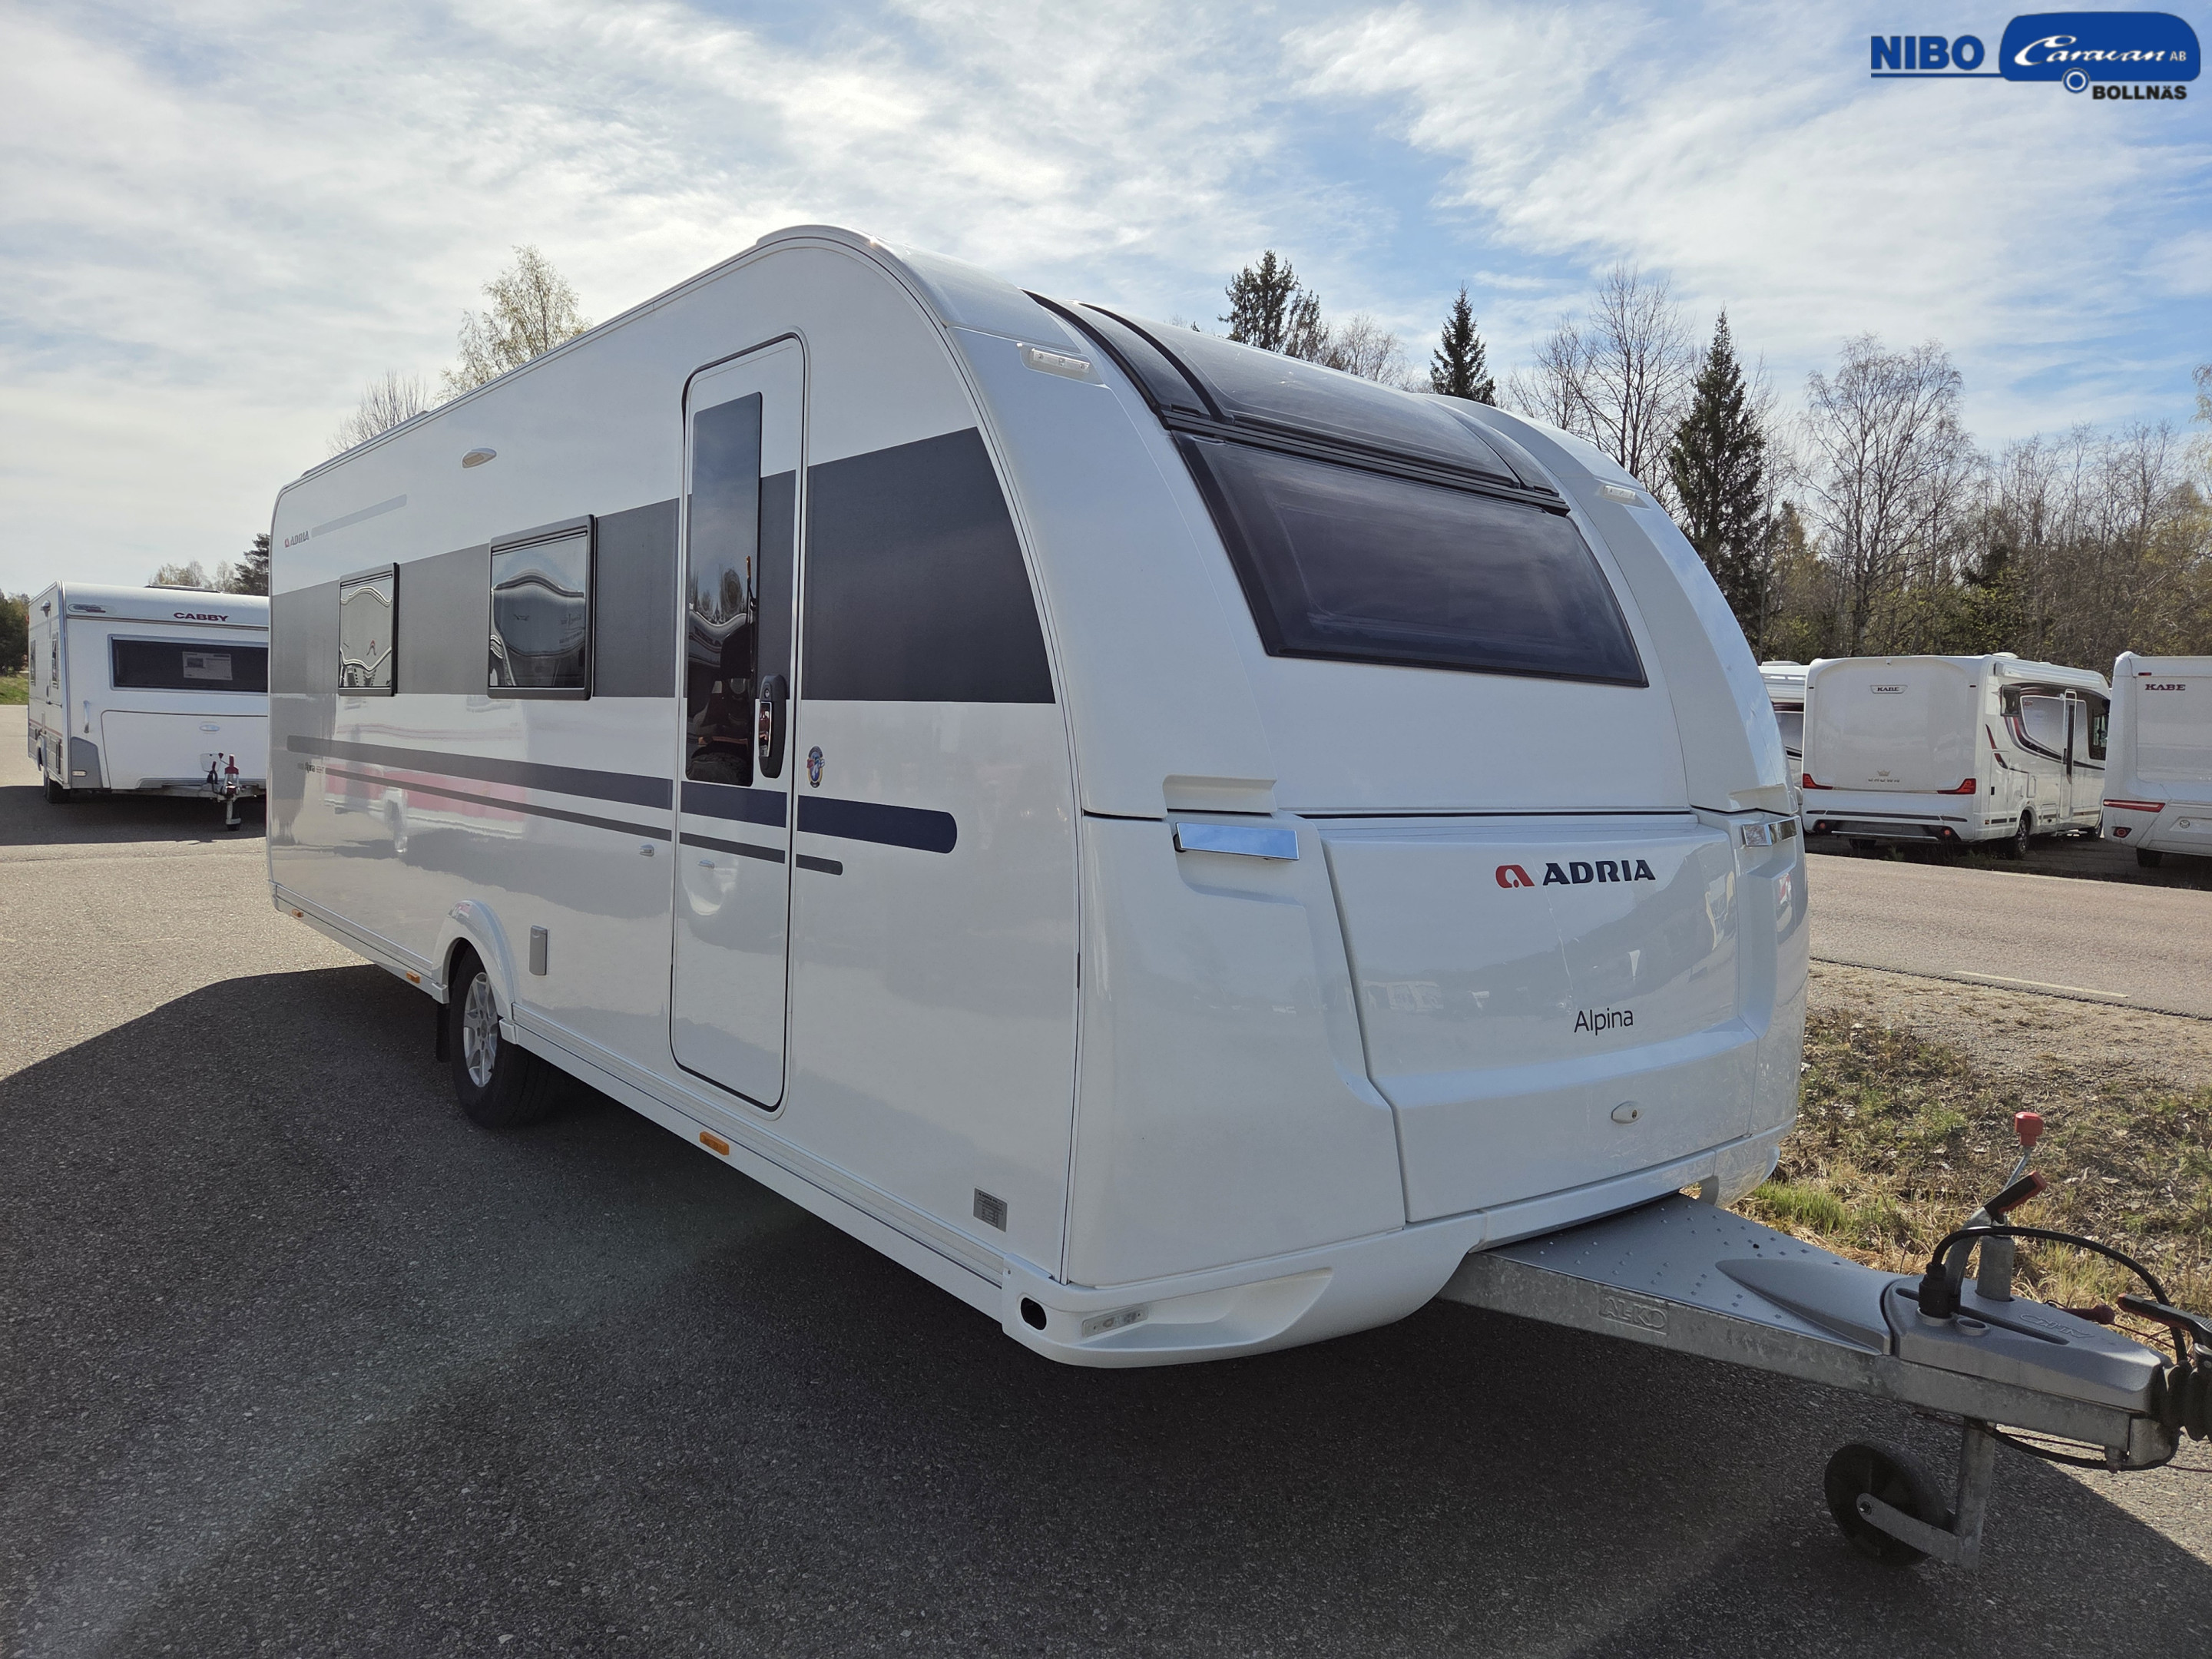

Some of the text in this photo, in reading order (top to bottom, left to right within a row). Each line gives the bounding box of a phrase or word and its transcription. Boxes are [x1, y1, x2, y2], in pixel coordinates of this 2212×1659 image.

[173, 612, 229, 621] CABBY
[1542, 859, 1656, 886] ADRIA
[1574, 1007, 1634, 1036] Alpina
